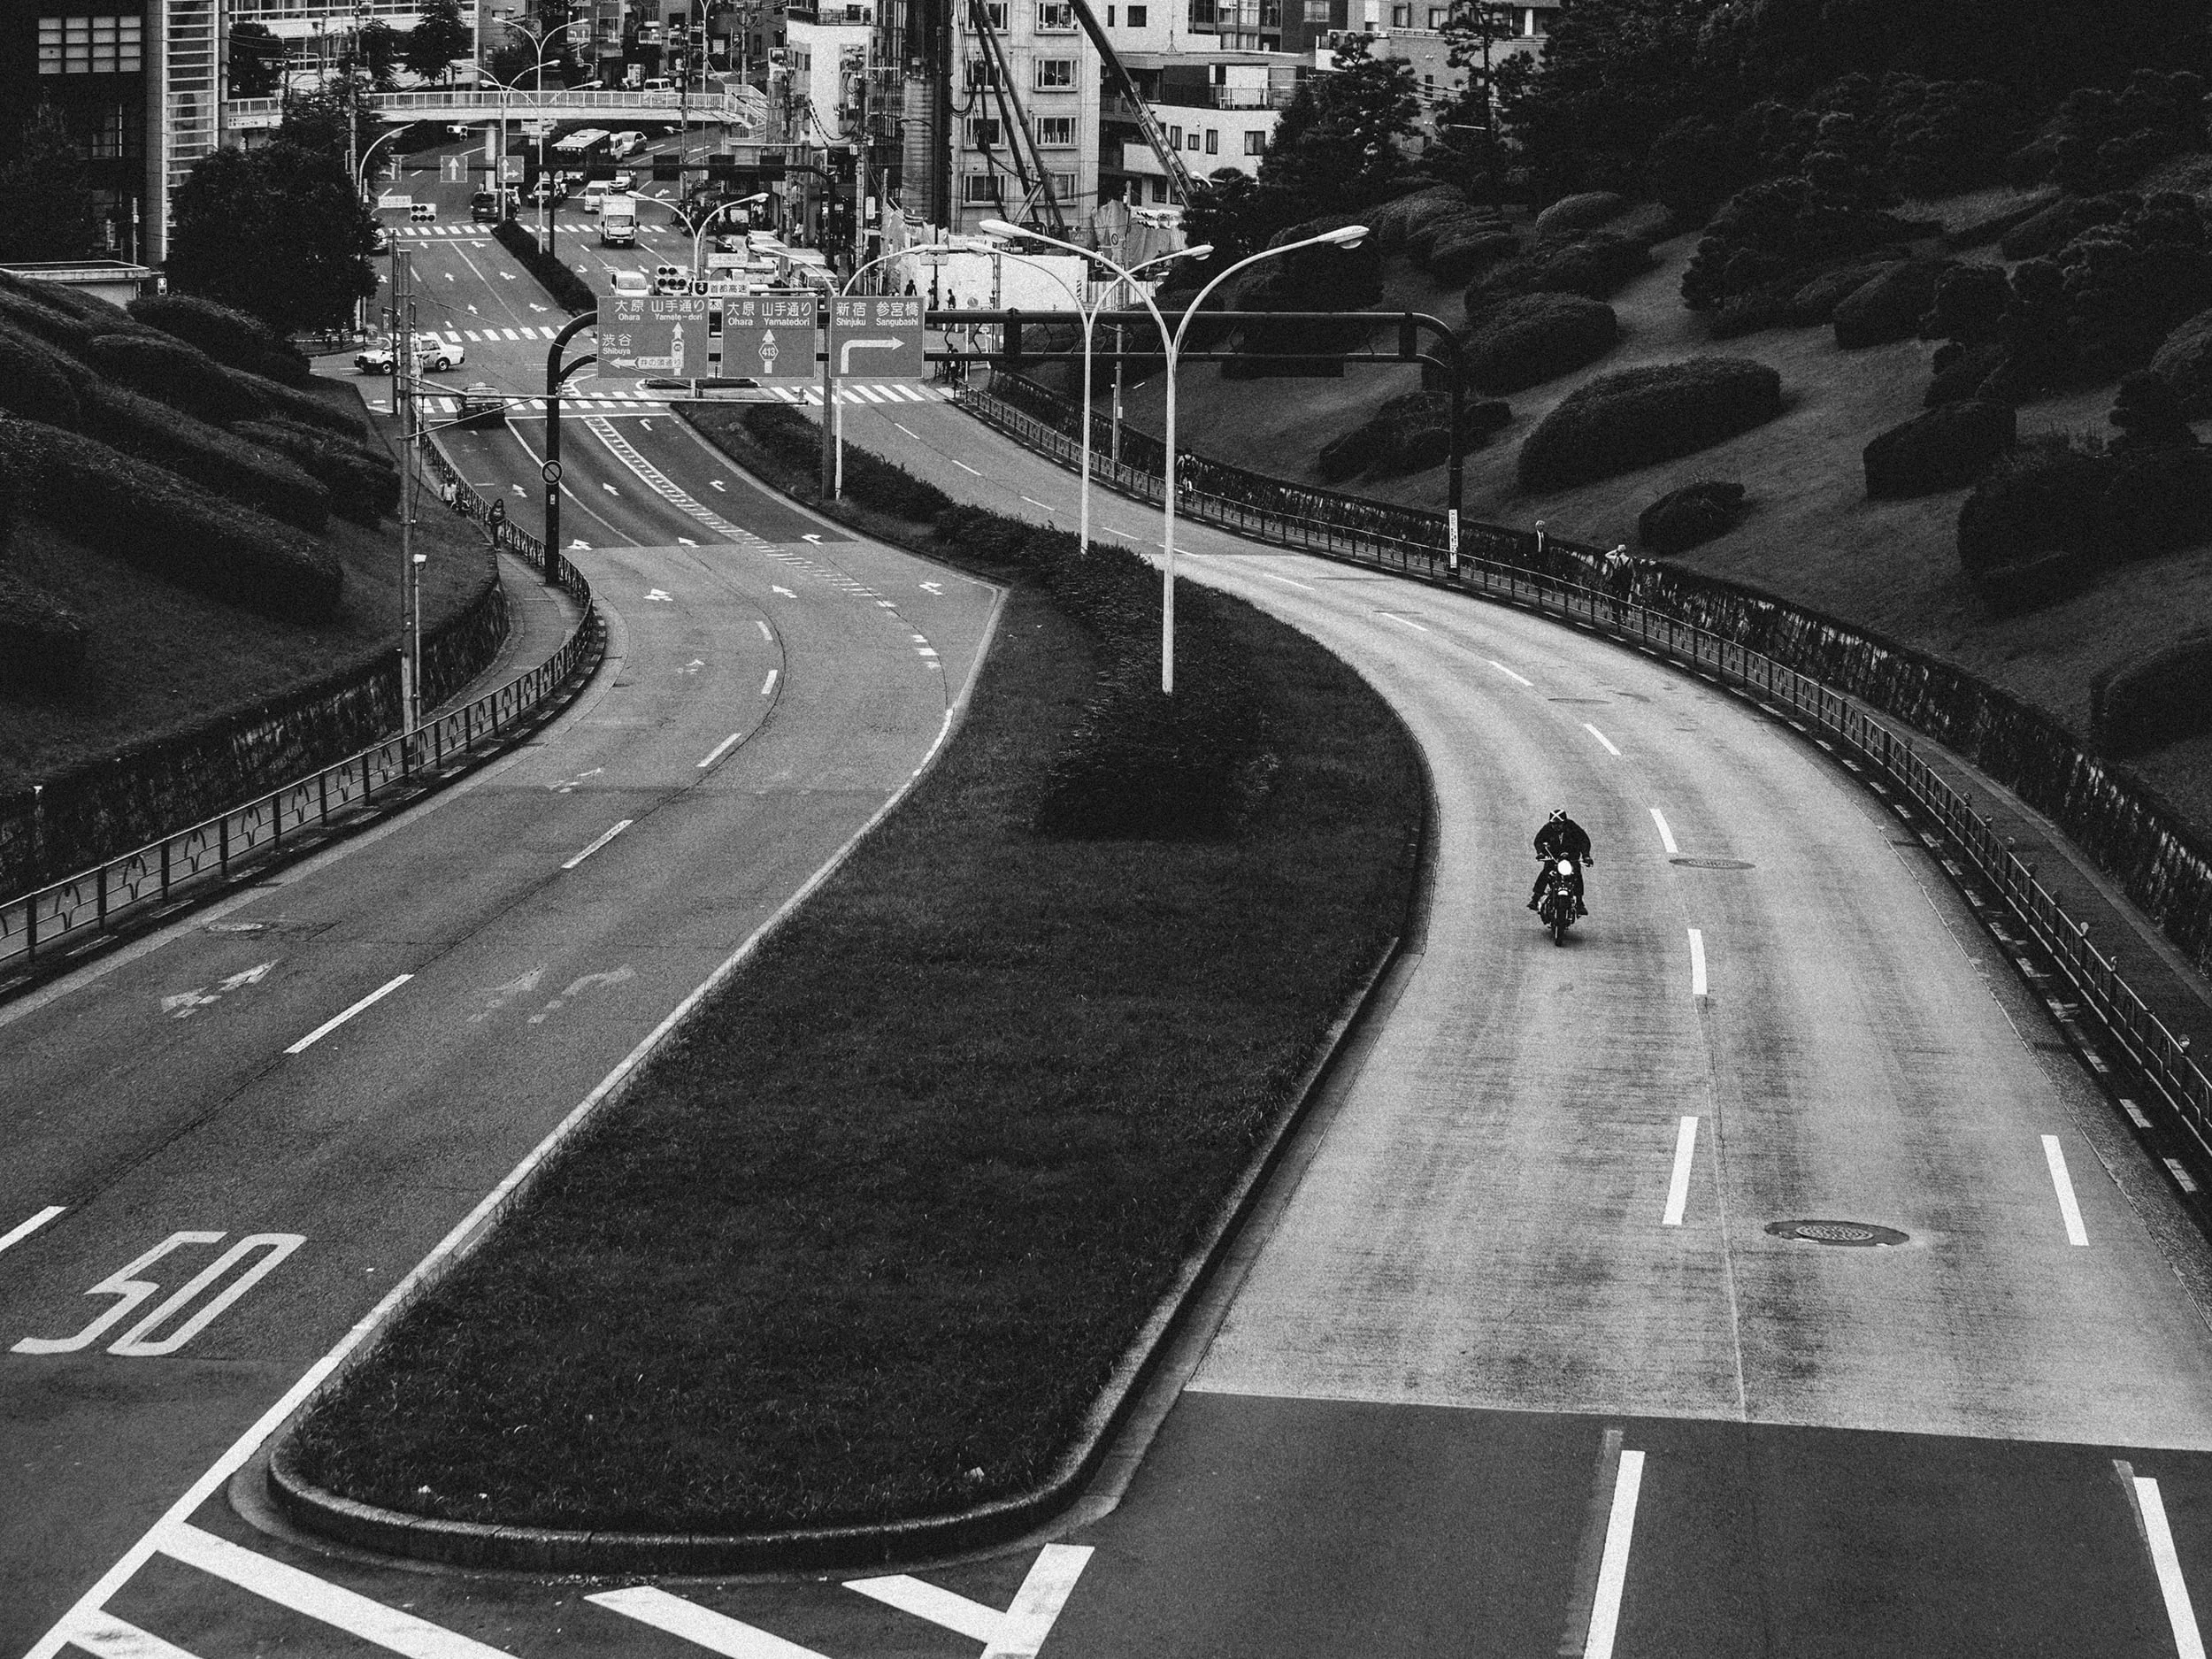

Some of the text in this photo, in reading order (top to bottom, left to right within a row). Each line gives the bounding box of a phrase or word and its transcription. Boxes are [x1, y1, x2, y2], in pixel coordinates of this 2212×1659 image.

[614, 300, 645, 312] 大原
[651, 299, 705, 312] 山手通り
[726, 302, 756, 316] 大原
[761, 302, 812, 317] 山手通り
[836, 302, 919, 317] 新宿 参宮橋
[764, 318, 810, 326] Yamatedori
[836, 318, 918, 327] Shinjuku Sangubashi
[602, 334, 632, 347] 渋谷
[762, 348, 776, 357] 413
[10, 1230, 308, 1357] 50
